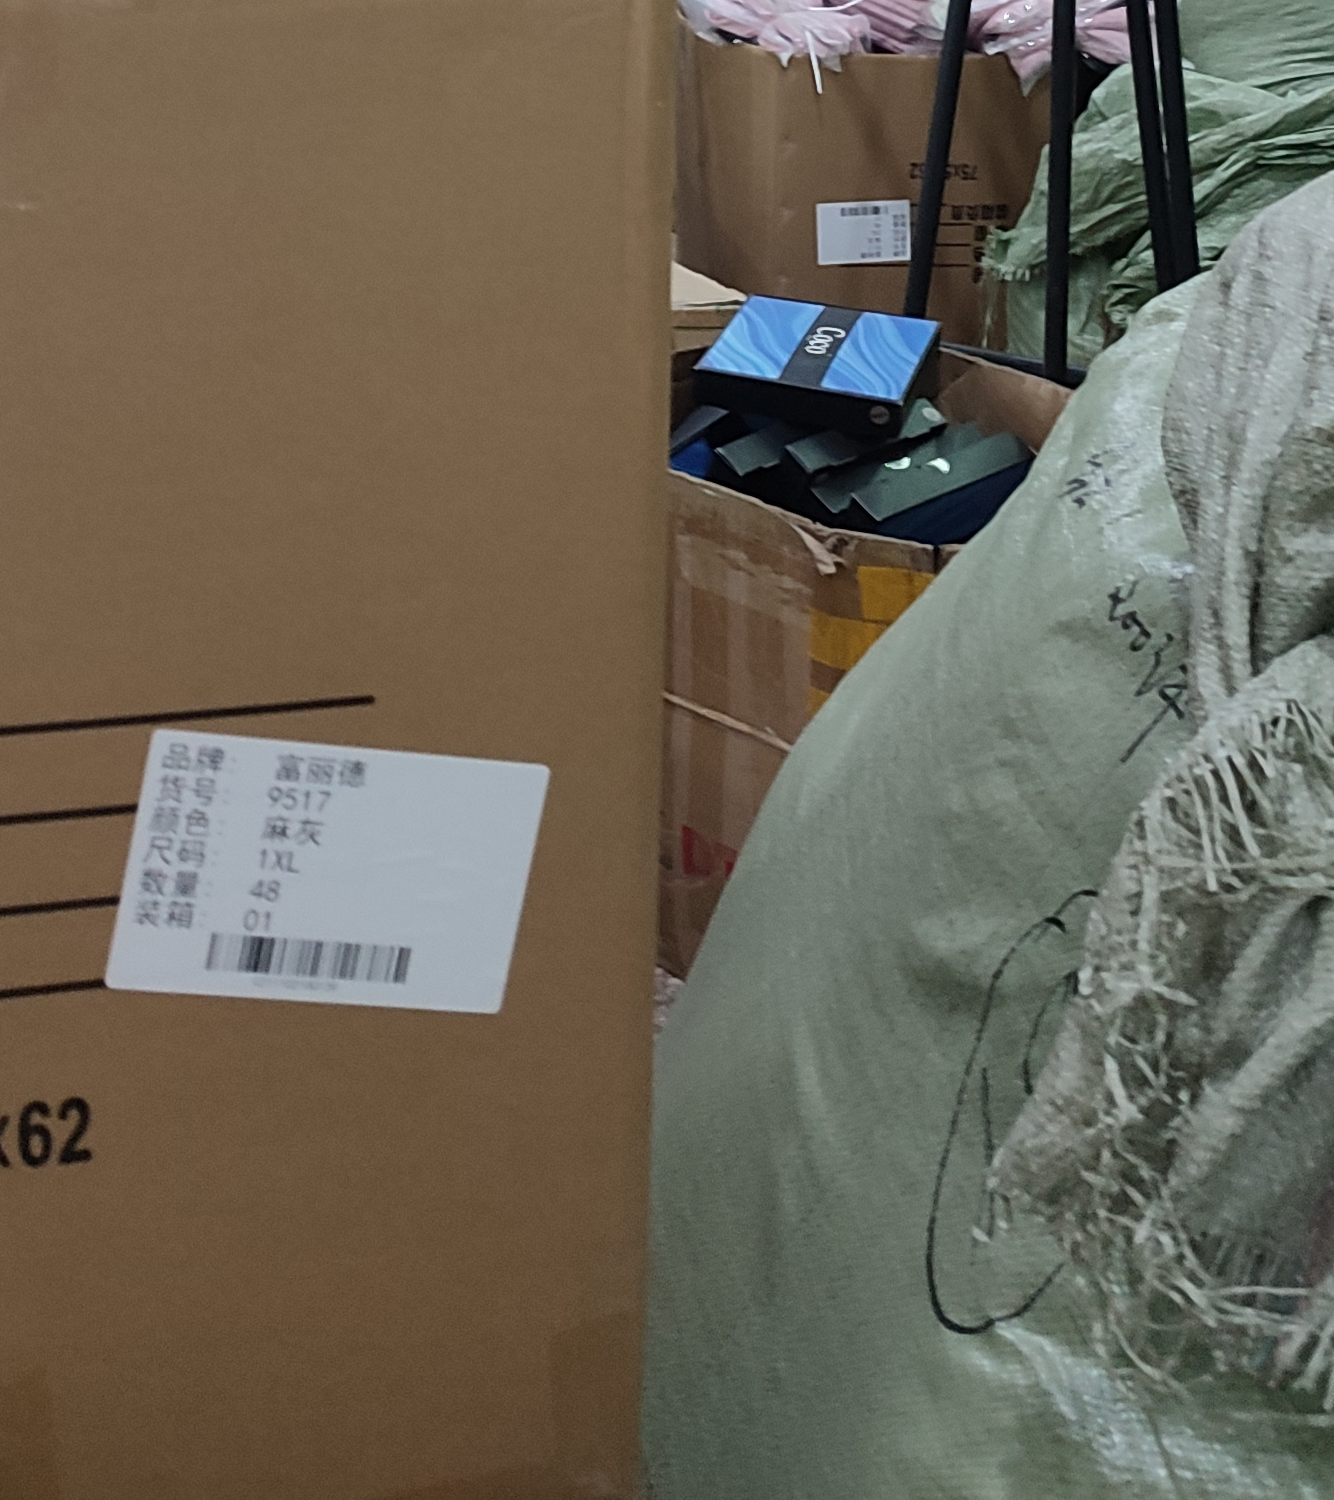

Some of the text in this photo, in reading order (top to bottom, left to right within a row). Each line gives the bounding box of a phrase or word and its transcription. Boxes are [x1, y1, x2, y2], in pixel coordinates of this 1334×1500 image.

[804, 326, 847, 355] Coco
[275, 753, 367, 788] 富丽德
[267, 786, 332, 813] 9517
[261, 816, 325, 846] 麻灰
[259, 848, 300, 875] 1XL
[248, 879, 281, 903] 48
[241, 907, 272, 933] 01
